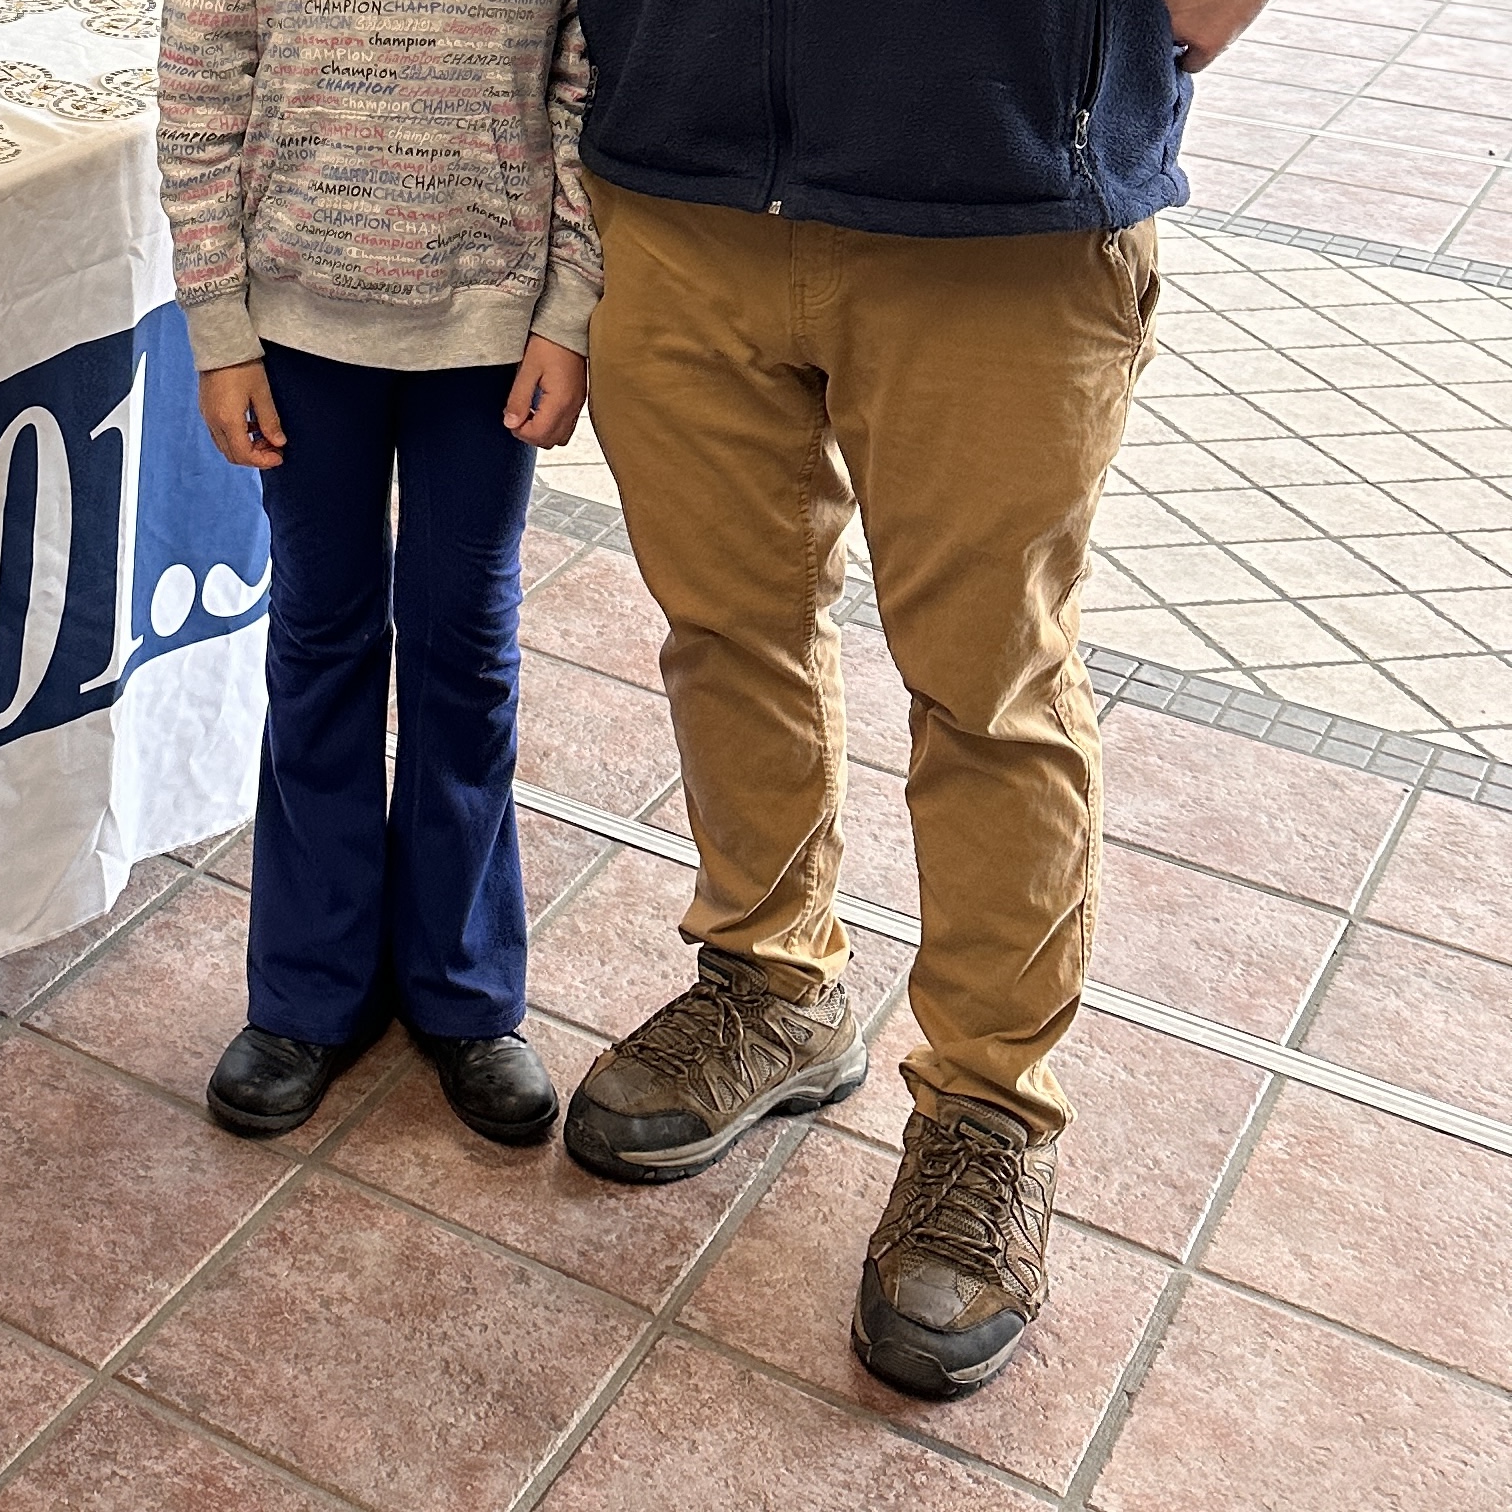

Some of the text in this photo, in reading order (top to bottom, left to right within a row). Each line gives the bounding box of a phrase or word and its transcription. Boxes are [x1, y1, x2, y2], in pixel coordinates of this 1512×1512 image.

[383, 1, 468, 15] CHAMPION
[368, 32, 437, 52] champion
[320, 60, 397, 81] champion
[317, 78, 399, 96] CHAMPION
[342, 96, 410, 113] champion
[411, 98, 492, 115] CHAMPION
[388, 142, 461, 161] champion
[402, 174, 483, 191] CHAMPION
[313, 210, 391, 232] CHAMPION
[295, 223, 353, 242] champion
[354, 233, 423, 250] champion
[301, 252, 361, 273] champion
